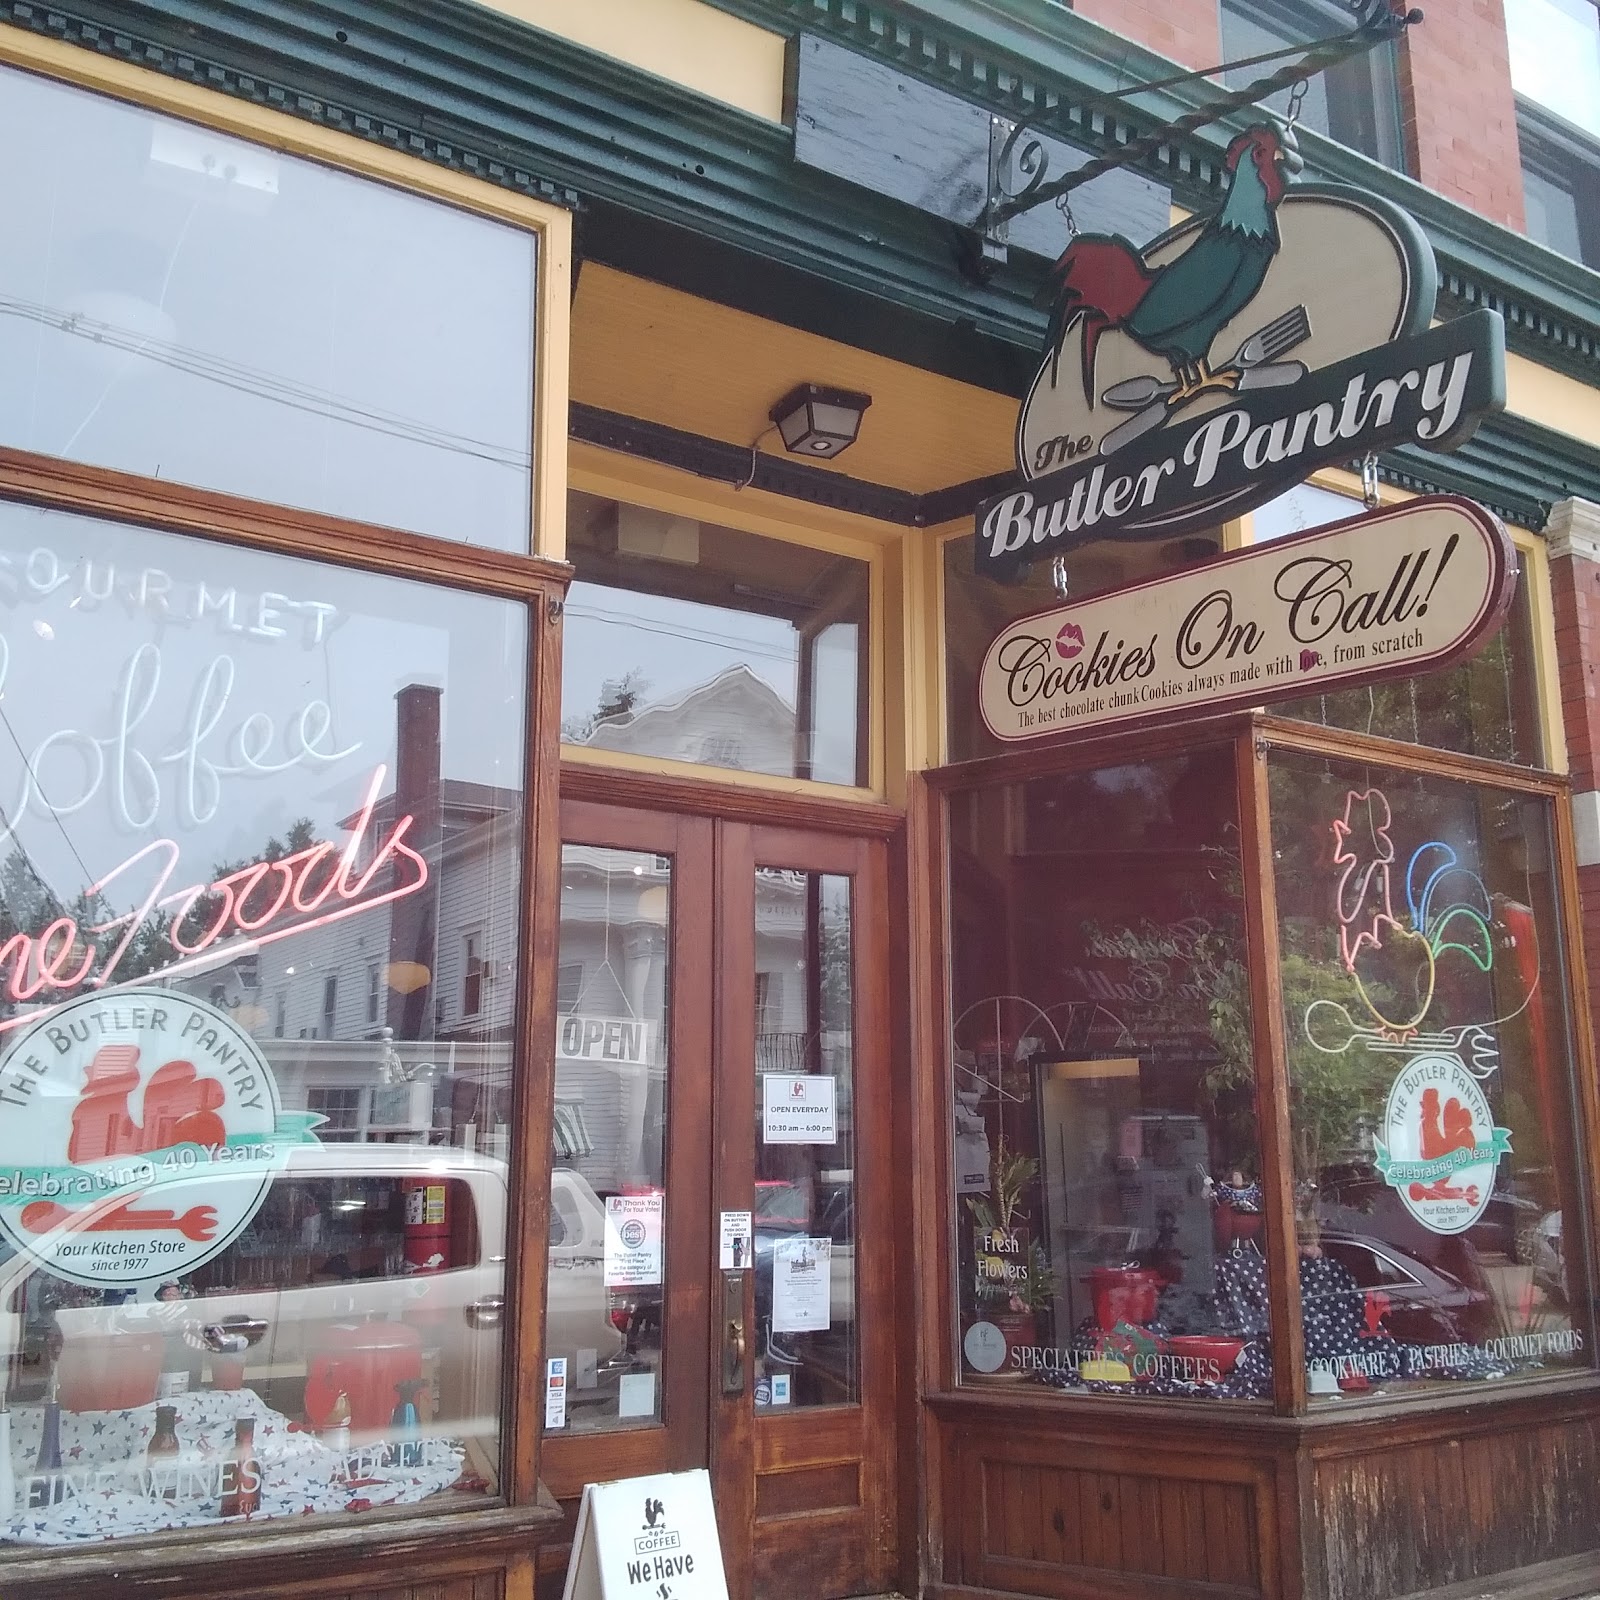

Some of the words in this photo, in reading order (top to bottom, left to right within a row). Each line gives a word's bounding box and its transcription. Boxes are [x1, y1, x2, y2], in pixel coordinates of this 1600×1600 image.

[982, 456, 1175, 558] Butler
[1184, 351, 1473, 488] Pantry
[1034, 431, 1093, 471] The
[0, 546, 338, 645] OURMET
[998, 630, 1158, 707] Cookies
[1175, 588, 1265, 670] On
[1274, 533, 1459, 644] Call!
[1018, 711, 1035, 728] The
[1038, 705, 1056, 724] best
[1060, 697, 1105, 719] chocolate
[1108, 688, 1140, 710] chunk
[1141, 681, 1183, 703] Cookies
[1187, 673, 1224, 694] always
[1230, 662, 1261, 684] made
[1266, 655, 1292, 676] with
[1333, 643, 1365, 664] from
[1372, 628, 1423, 656] scratch
[0, 632, 363, 842] offee
[84, 763, 428, 986] Foods
[0, 1055, 49, 1107] THE
[45, 1007, 168, 1055] BUTLER
[181, 1011, 264, 1112] PANTRY
[561, 1018, 643, 1061] OPEN
[1391, 1095, 1408, 1127] THE
[1403, 1065, 1447, 1096] BUTLER
[1451, 1068, 1488, 1128] PANTRY
[822, 1126, 832, 1134] pm
[0, 1161, 156, 1197] elebrating
[162, 1147, 197, 1172] 40
[201, 1141, 275, 1164] Years
[1388, 1157, 1454, 1181] Celebrating
[1455, 1150, 1467, 1166] 40
[1469, 1146, 1496, 1162] Years
[1423, 1206, 1435, 1215] Your
[1436, 1206, 1455, 1215] Kitchen
[1456, 1205, 1470, 1214] Store
[55, 1241, 88, 1257] Your
[91, 1239, 145, 1256] Kitchen
[148, 1239, 186, 1254] Store
[90, 1259, 120, 1272] since
[123, 1258, 149, 1271] 1977
[983, 1235, 1019, 1254] Fresh
[977, 1260, 1028, 1280] Flowers
[1132, 1353, 1221, 1383] COFFEES
[1309, 1351, 1389, 1379] COOKWARE
[1408, 1342, 1469, 1372] PASTRIES
[1485, 1333, 1543, 1362] GOURMET
[1547, 1328, 1585, 1354] FOODS
[23, 1471, 116, 1510] FINE
[134, 1457, 263, 1500] WINES
[638, 1535, 677, 1551] COFFEE
[627, 1560, 652, 1585] We
[653, 1554, 694, 1580] Have
